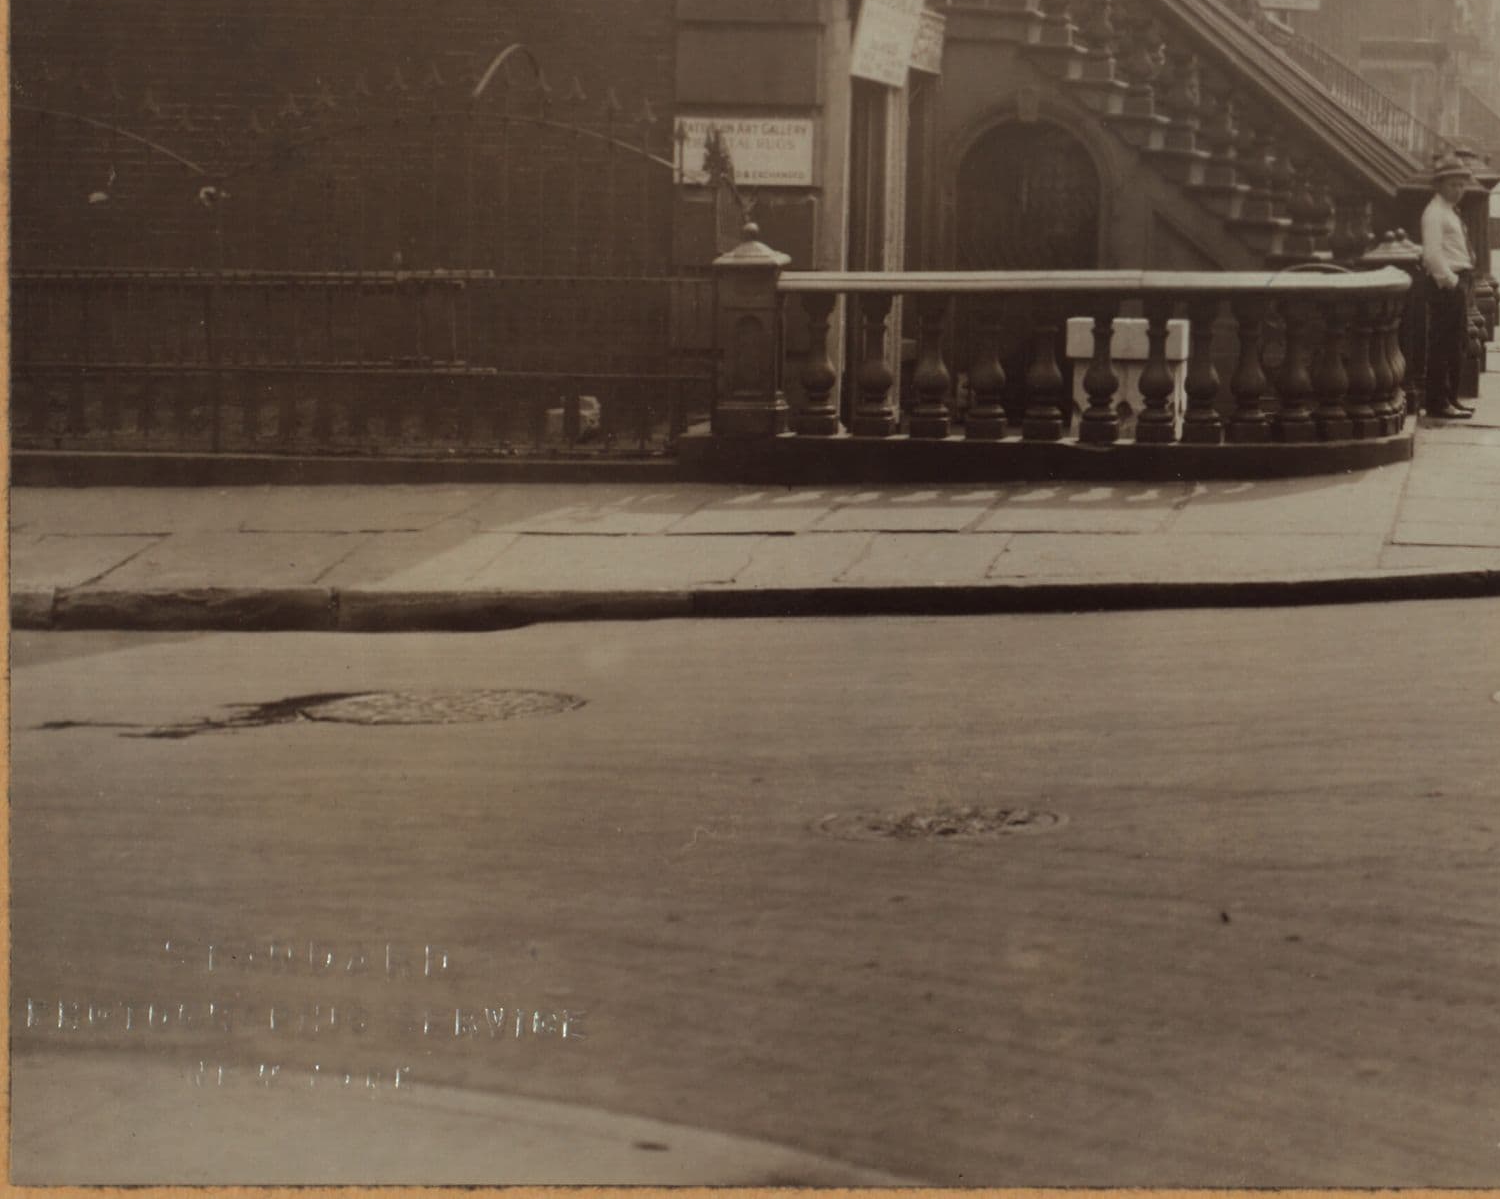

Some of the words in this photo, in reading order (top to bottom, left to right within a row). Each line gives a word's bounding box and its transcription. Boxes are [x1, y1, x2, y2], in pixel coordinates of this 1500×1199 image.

[737, 122, 758, 135] ART
[761, 122, 807, 136] GALLERY
[757, 138, 796, 151] RUGS
